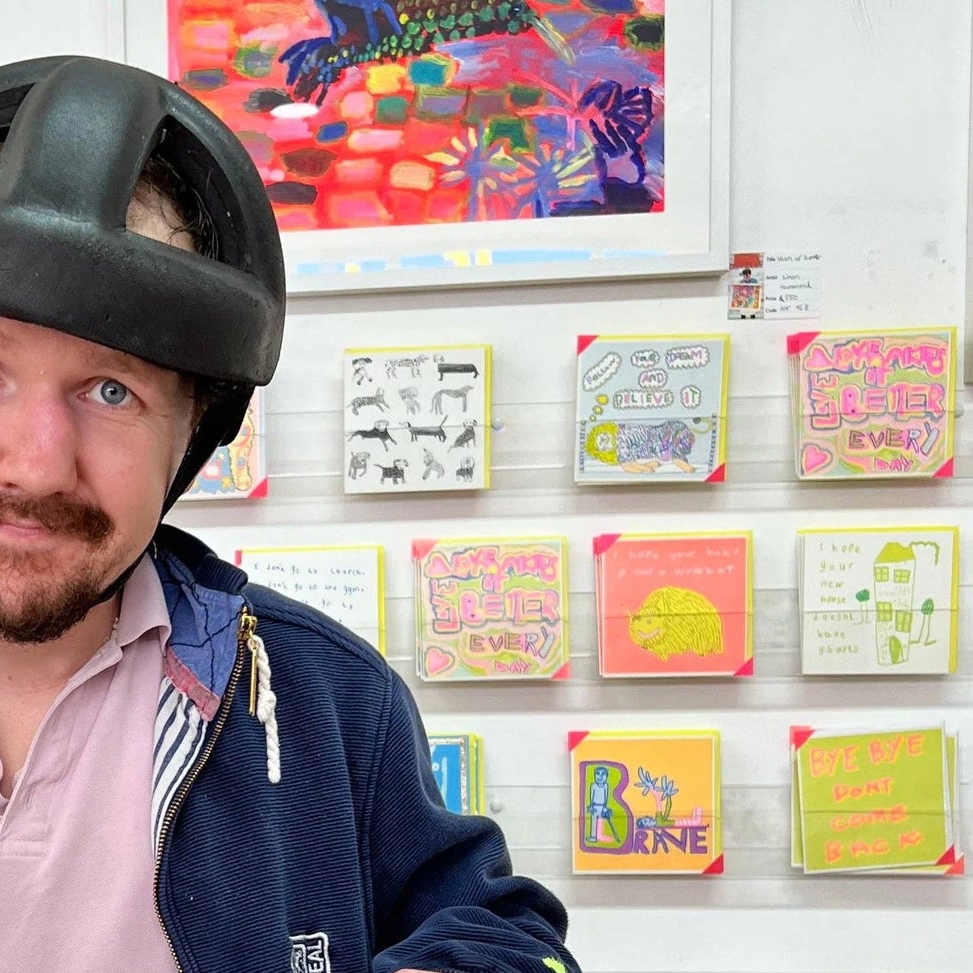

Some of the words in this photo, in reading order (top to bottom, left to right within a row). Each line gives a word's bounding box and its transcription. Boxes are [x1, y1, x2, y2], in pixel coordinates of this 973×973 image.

[641, 372, 664, 384] AND
[614, 392, 671, 405] BELIEVE
[683, 388, 699, 405] IT
[840, 383, 945, 419] BETTER
[849, 421, 940, 457] EVERY
[873, 455, 913, 472] DAY
[819, 561, 854, 573] your
[820, 580, 844, 589] new
[459, 588, 560, 625] BETTER
[820, 596, 847, 604] house
[469, 626, 556, 660] EVERY
[816, 629, 846, 639] have
[818, 644, 859, 655] ghosts
[494, 656, 533, 674] DAY
[809, 745, 859, 778] BYE
[868, 733, 925, 765] BYE
[833, 776, 893, 803] DONT
[579, 760, 709, 855] BRAVE
[831, 804, 908, 832] COME
[825, 828, 924, 864] BACK
